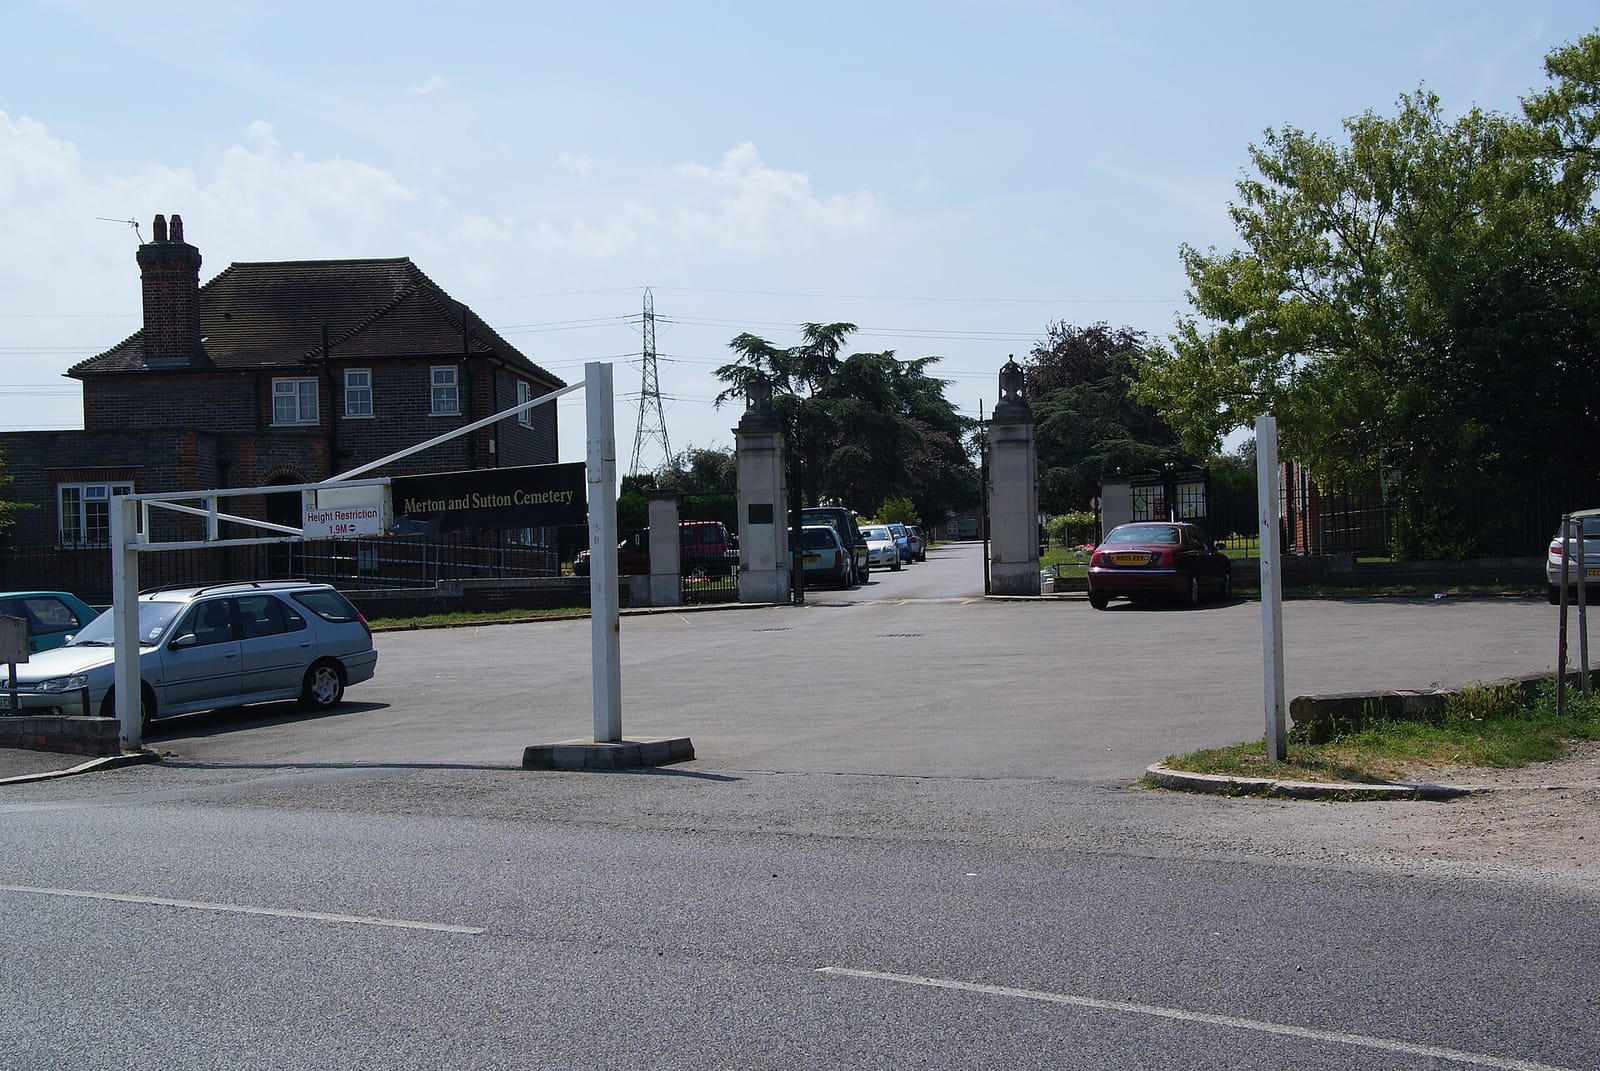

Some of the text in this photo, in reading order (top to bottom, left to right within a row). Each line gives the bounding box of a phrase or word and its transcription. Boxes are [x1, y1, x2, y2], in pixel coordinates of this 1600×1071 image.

[404, 489, 573, 514] Merton and Sutton Cemetery
[307, 509, 378, 524] Height Restriction
[329, 524, 347, 534] 1.9M
